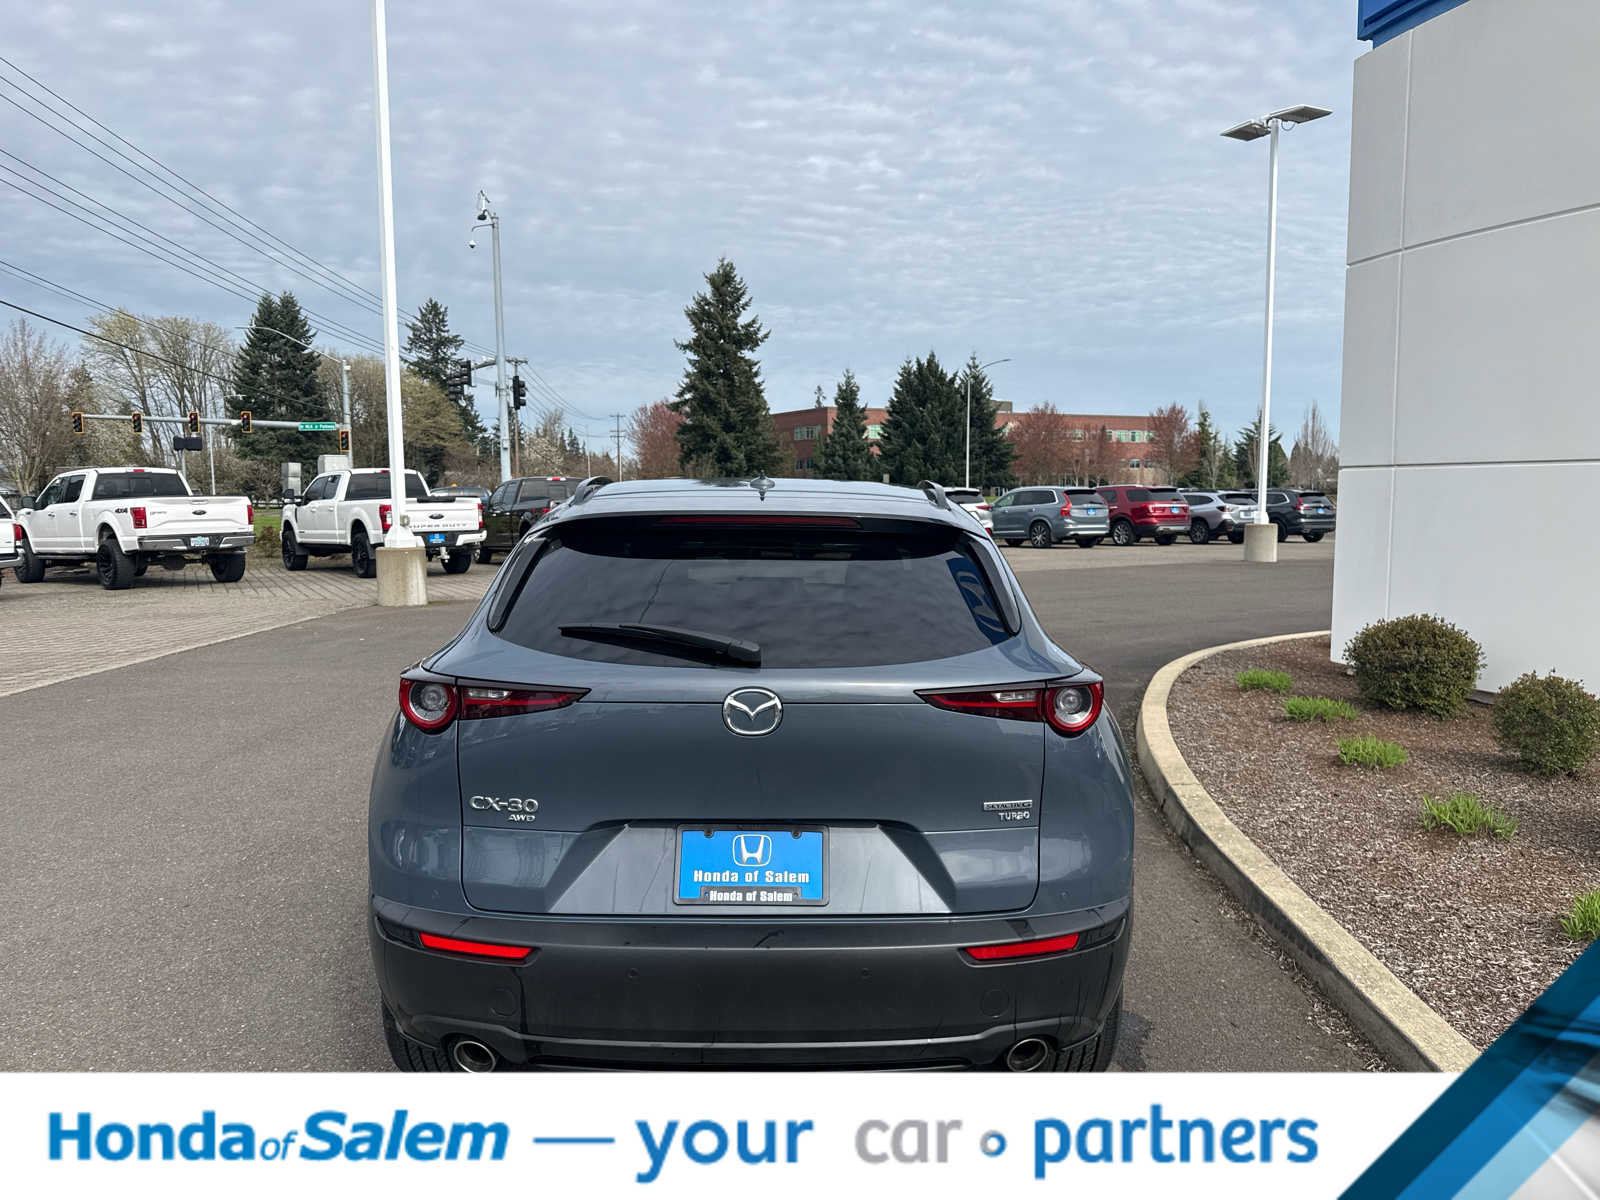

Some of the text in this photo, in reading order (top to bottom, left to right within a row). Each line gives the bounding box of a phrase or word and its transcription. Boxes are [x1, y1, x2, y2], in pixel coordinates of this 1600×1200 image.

[469, 795, 539, 813] CX-30
[508, 814, 536, 822] AWD
[998, 811, 1030, 821] TURBO
[693, 869, 810, 883] Honda of Salem
[709, 890, 793, 902] Honda of Salem
